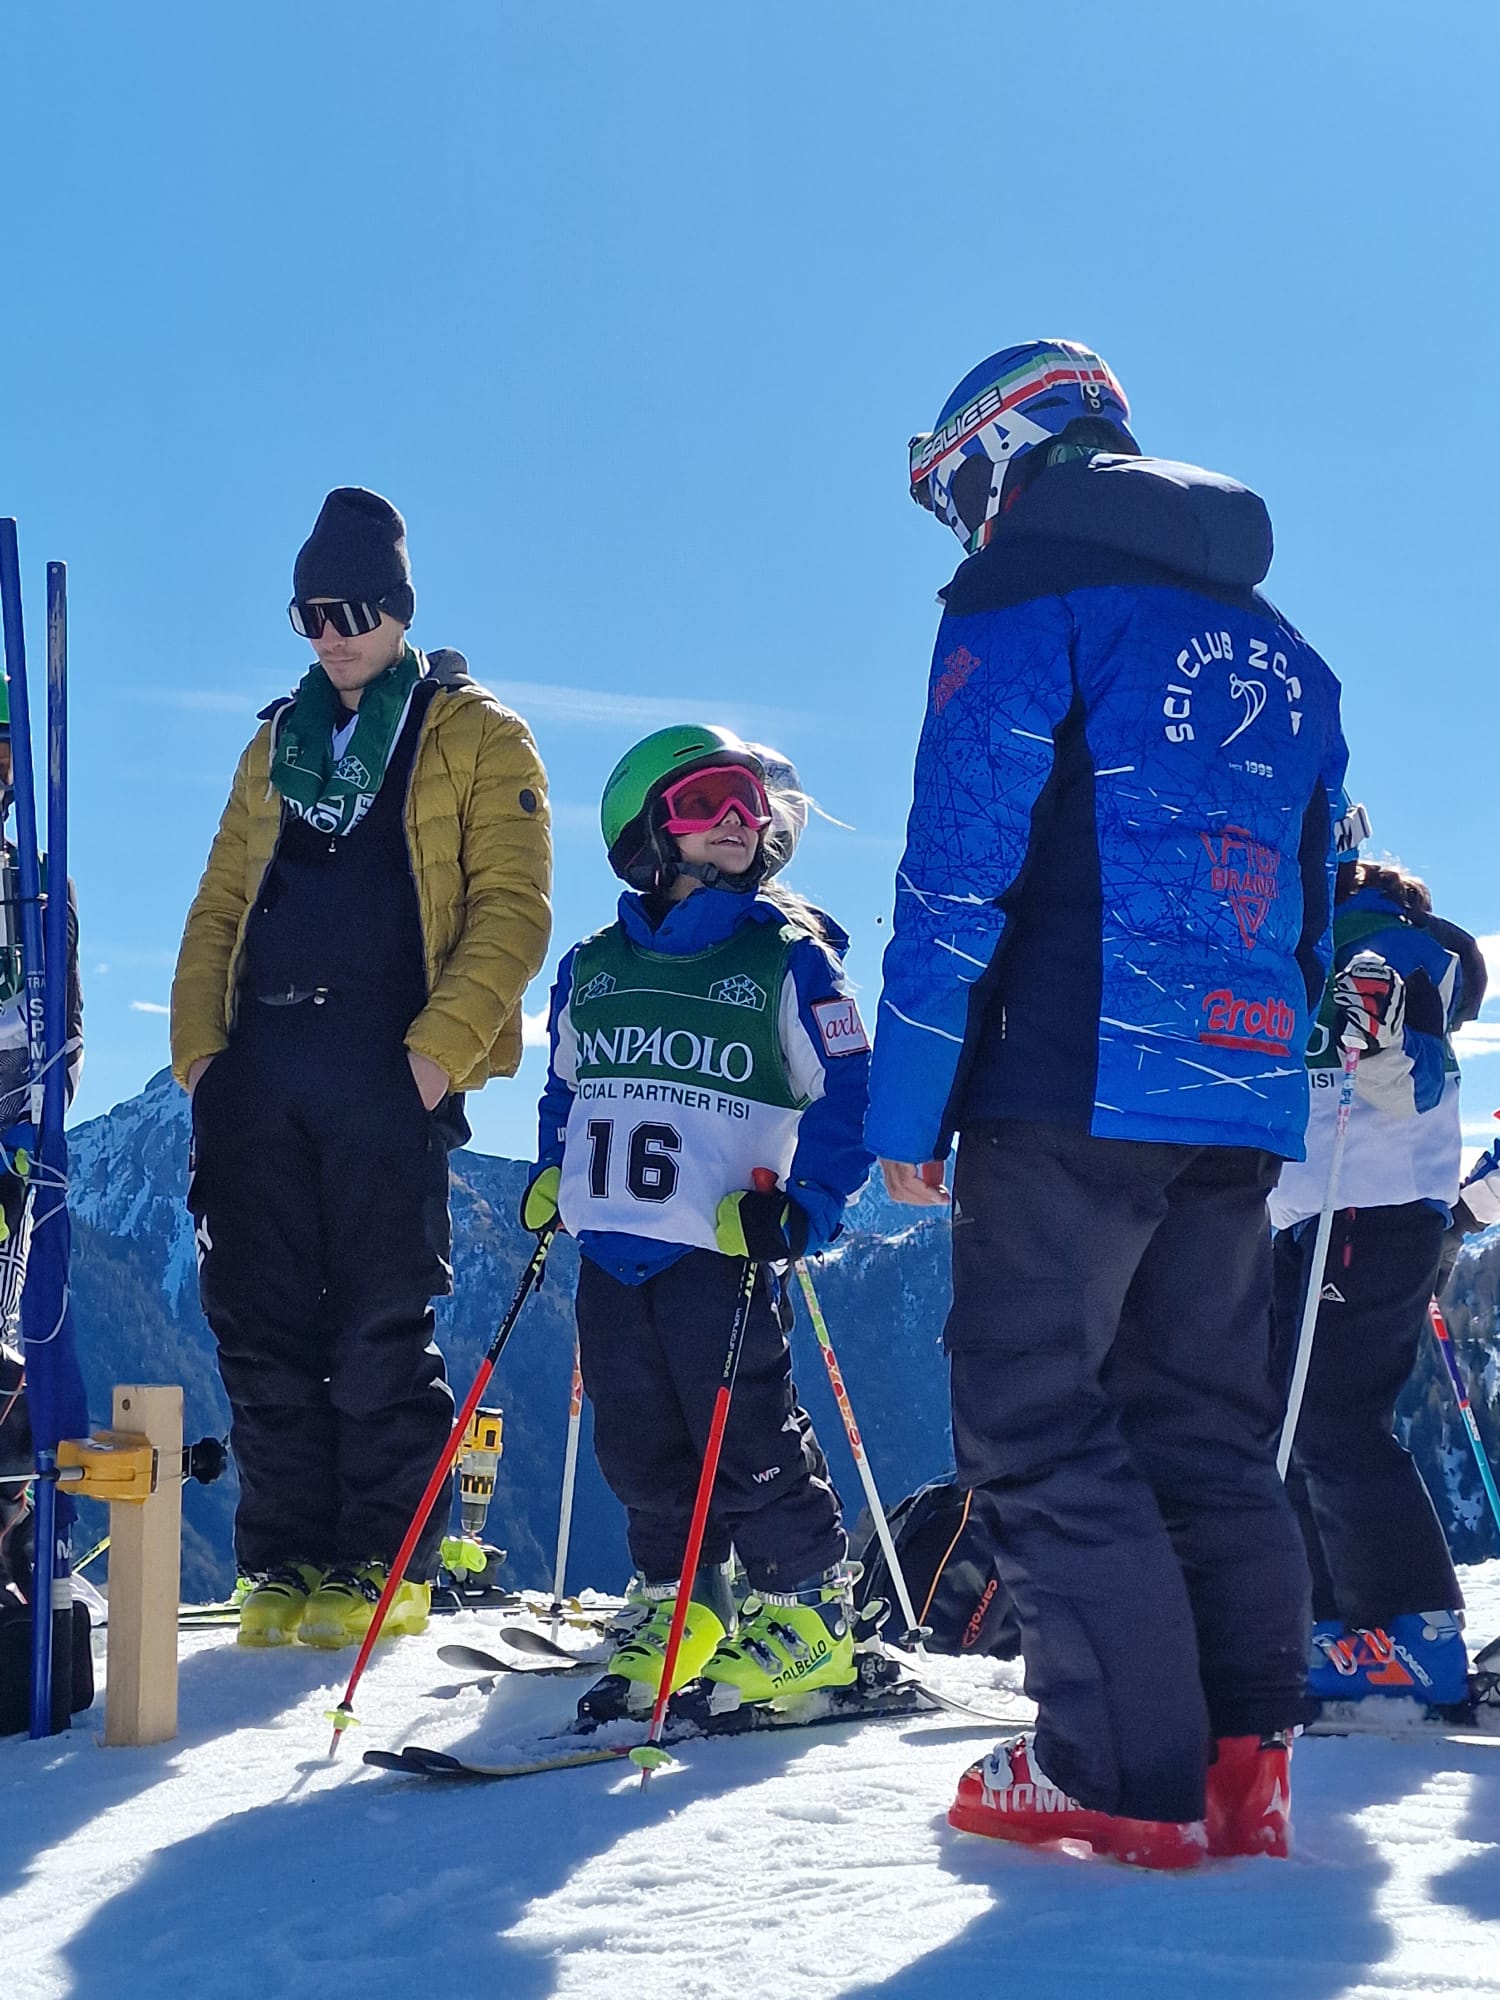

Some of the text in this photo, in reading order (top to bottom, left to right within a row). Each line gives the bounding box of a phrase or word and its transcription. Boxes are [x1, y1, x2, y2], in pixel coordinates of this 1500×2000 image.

[920, 387, 1002, 469] SALICE
[1177, 631, 1234, 679] CLUB
[1163, 684, 1195, 742] SCI
[623, 1084, 710, 1111] PARTNER
[717, 1097, 750, 1121] FISI
[586, 1118, 683, 1205] 16
[968, 1580, 998, 1632] carrot
[771, 1640, 827, 1689] DALBELLO
